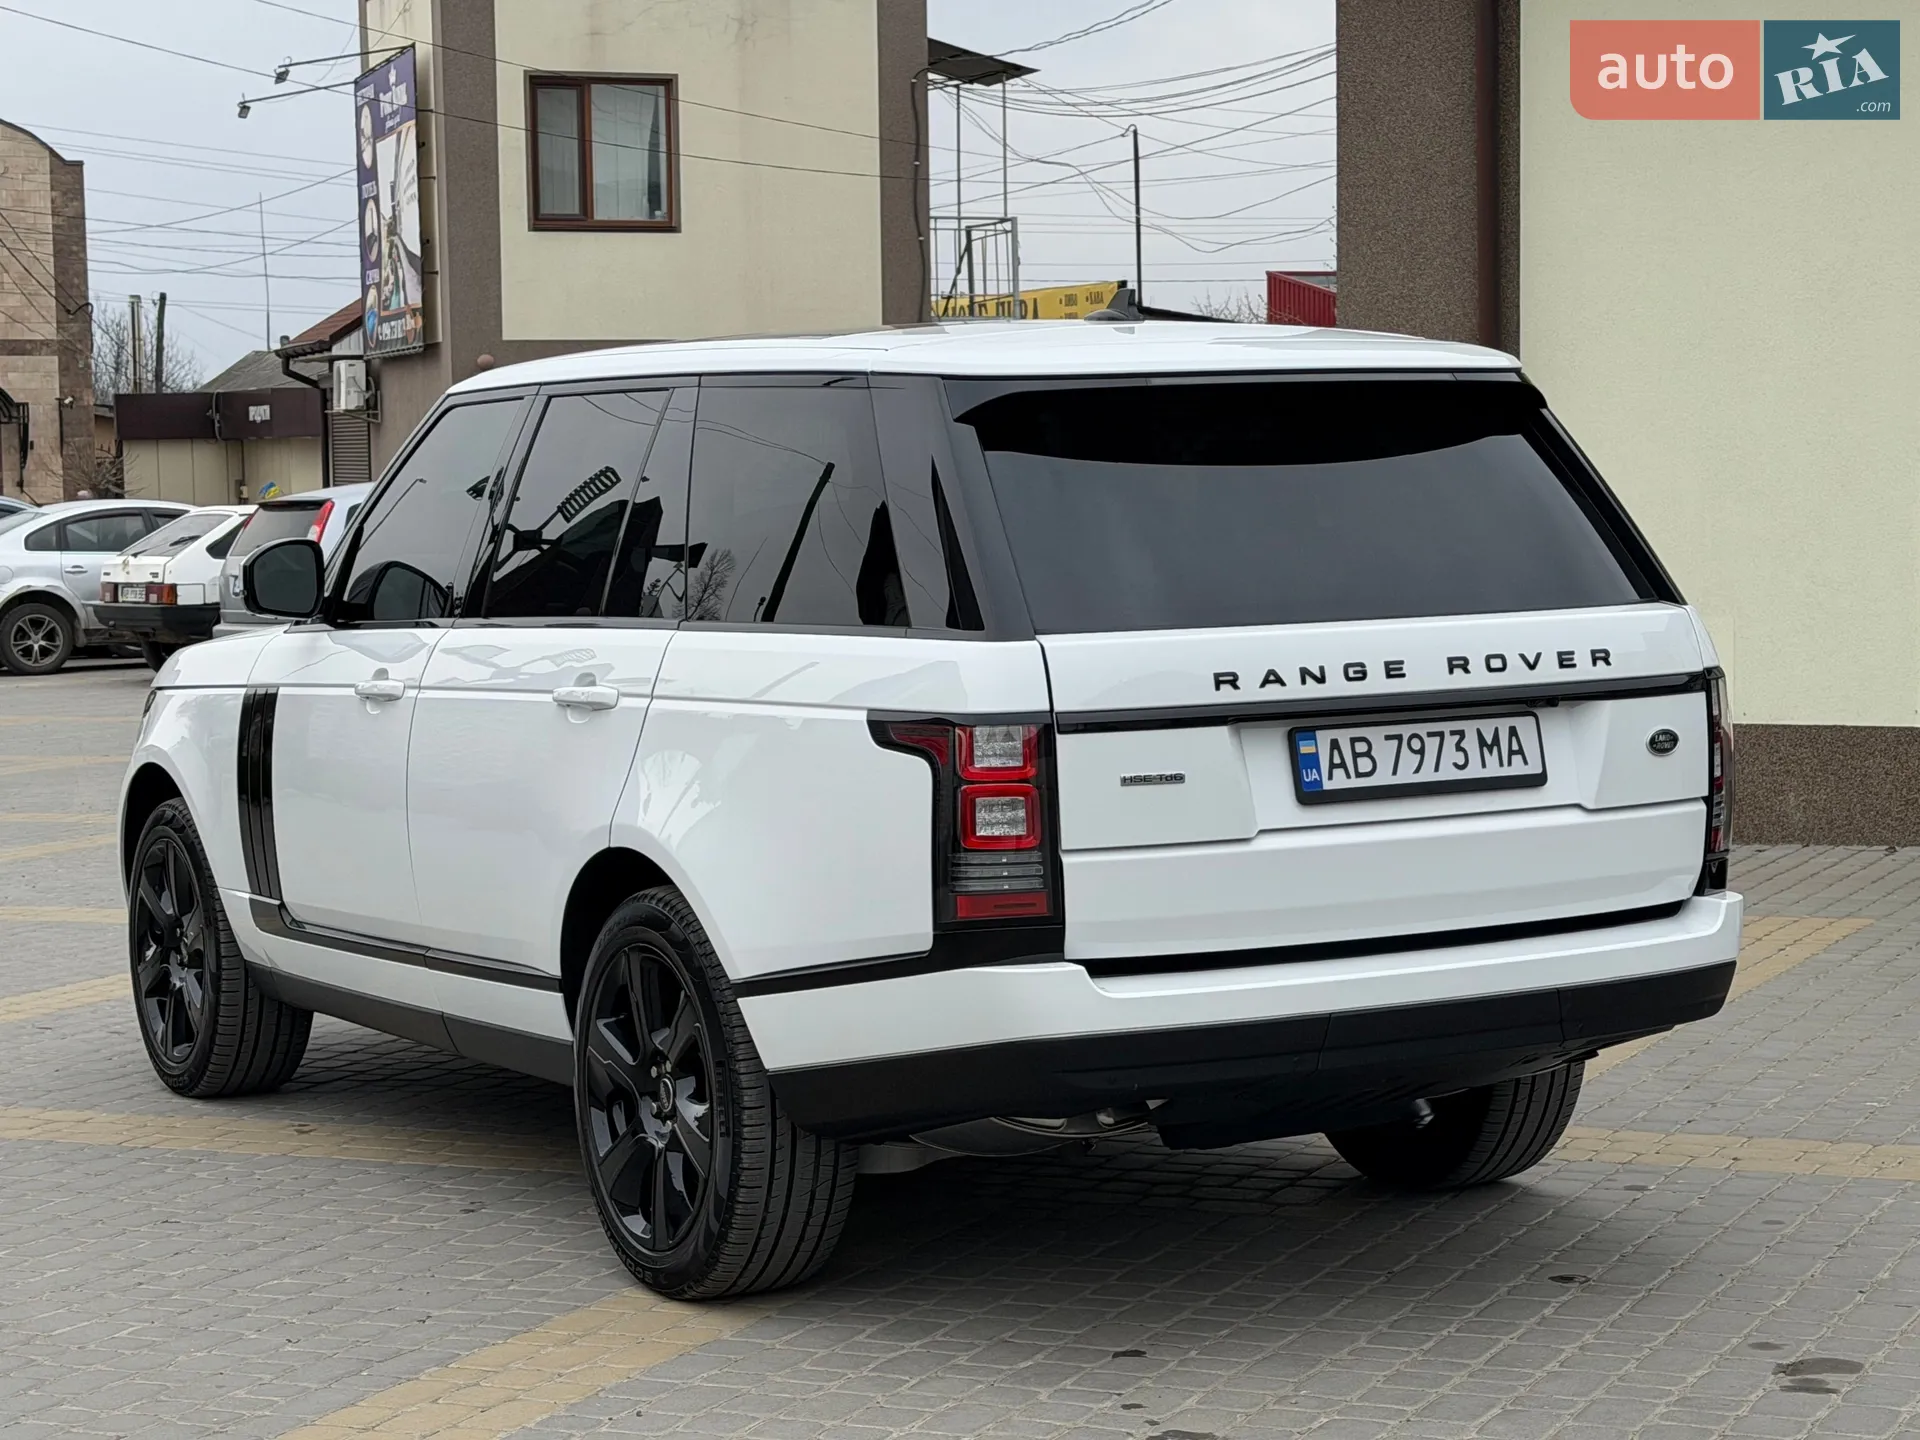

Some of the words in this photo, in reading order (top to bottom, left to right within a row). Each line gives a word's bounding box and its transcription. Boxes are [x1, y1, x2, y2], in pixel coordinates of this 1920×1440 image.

[1212, 659, 1408, 692] RANGE
[1446, 647, 1613, 676] ROVER
[1326, 735, 1378, 783] AB
[1383, 728, 1470, 777] 7973
[1476, 724, 1530, 770] MA
[1123, 774, 1153, 784] HSE
[1302, 767, 1321, 783] UA
